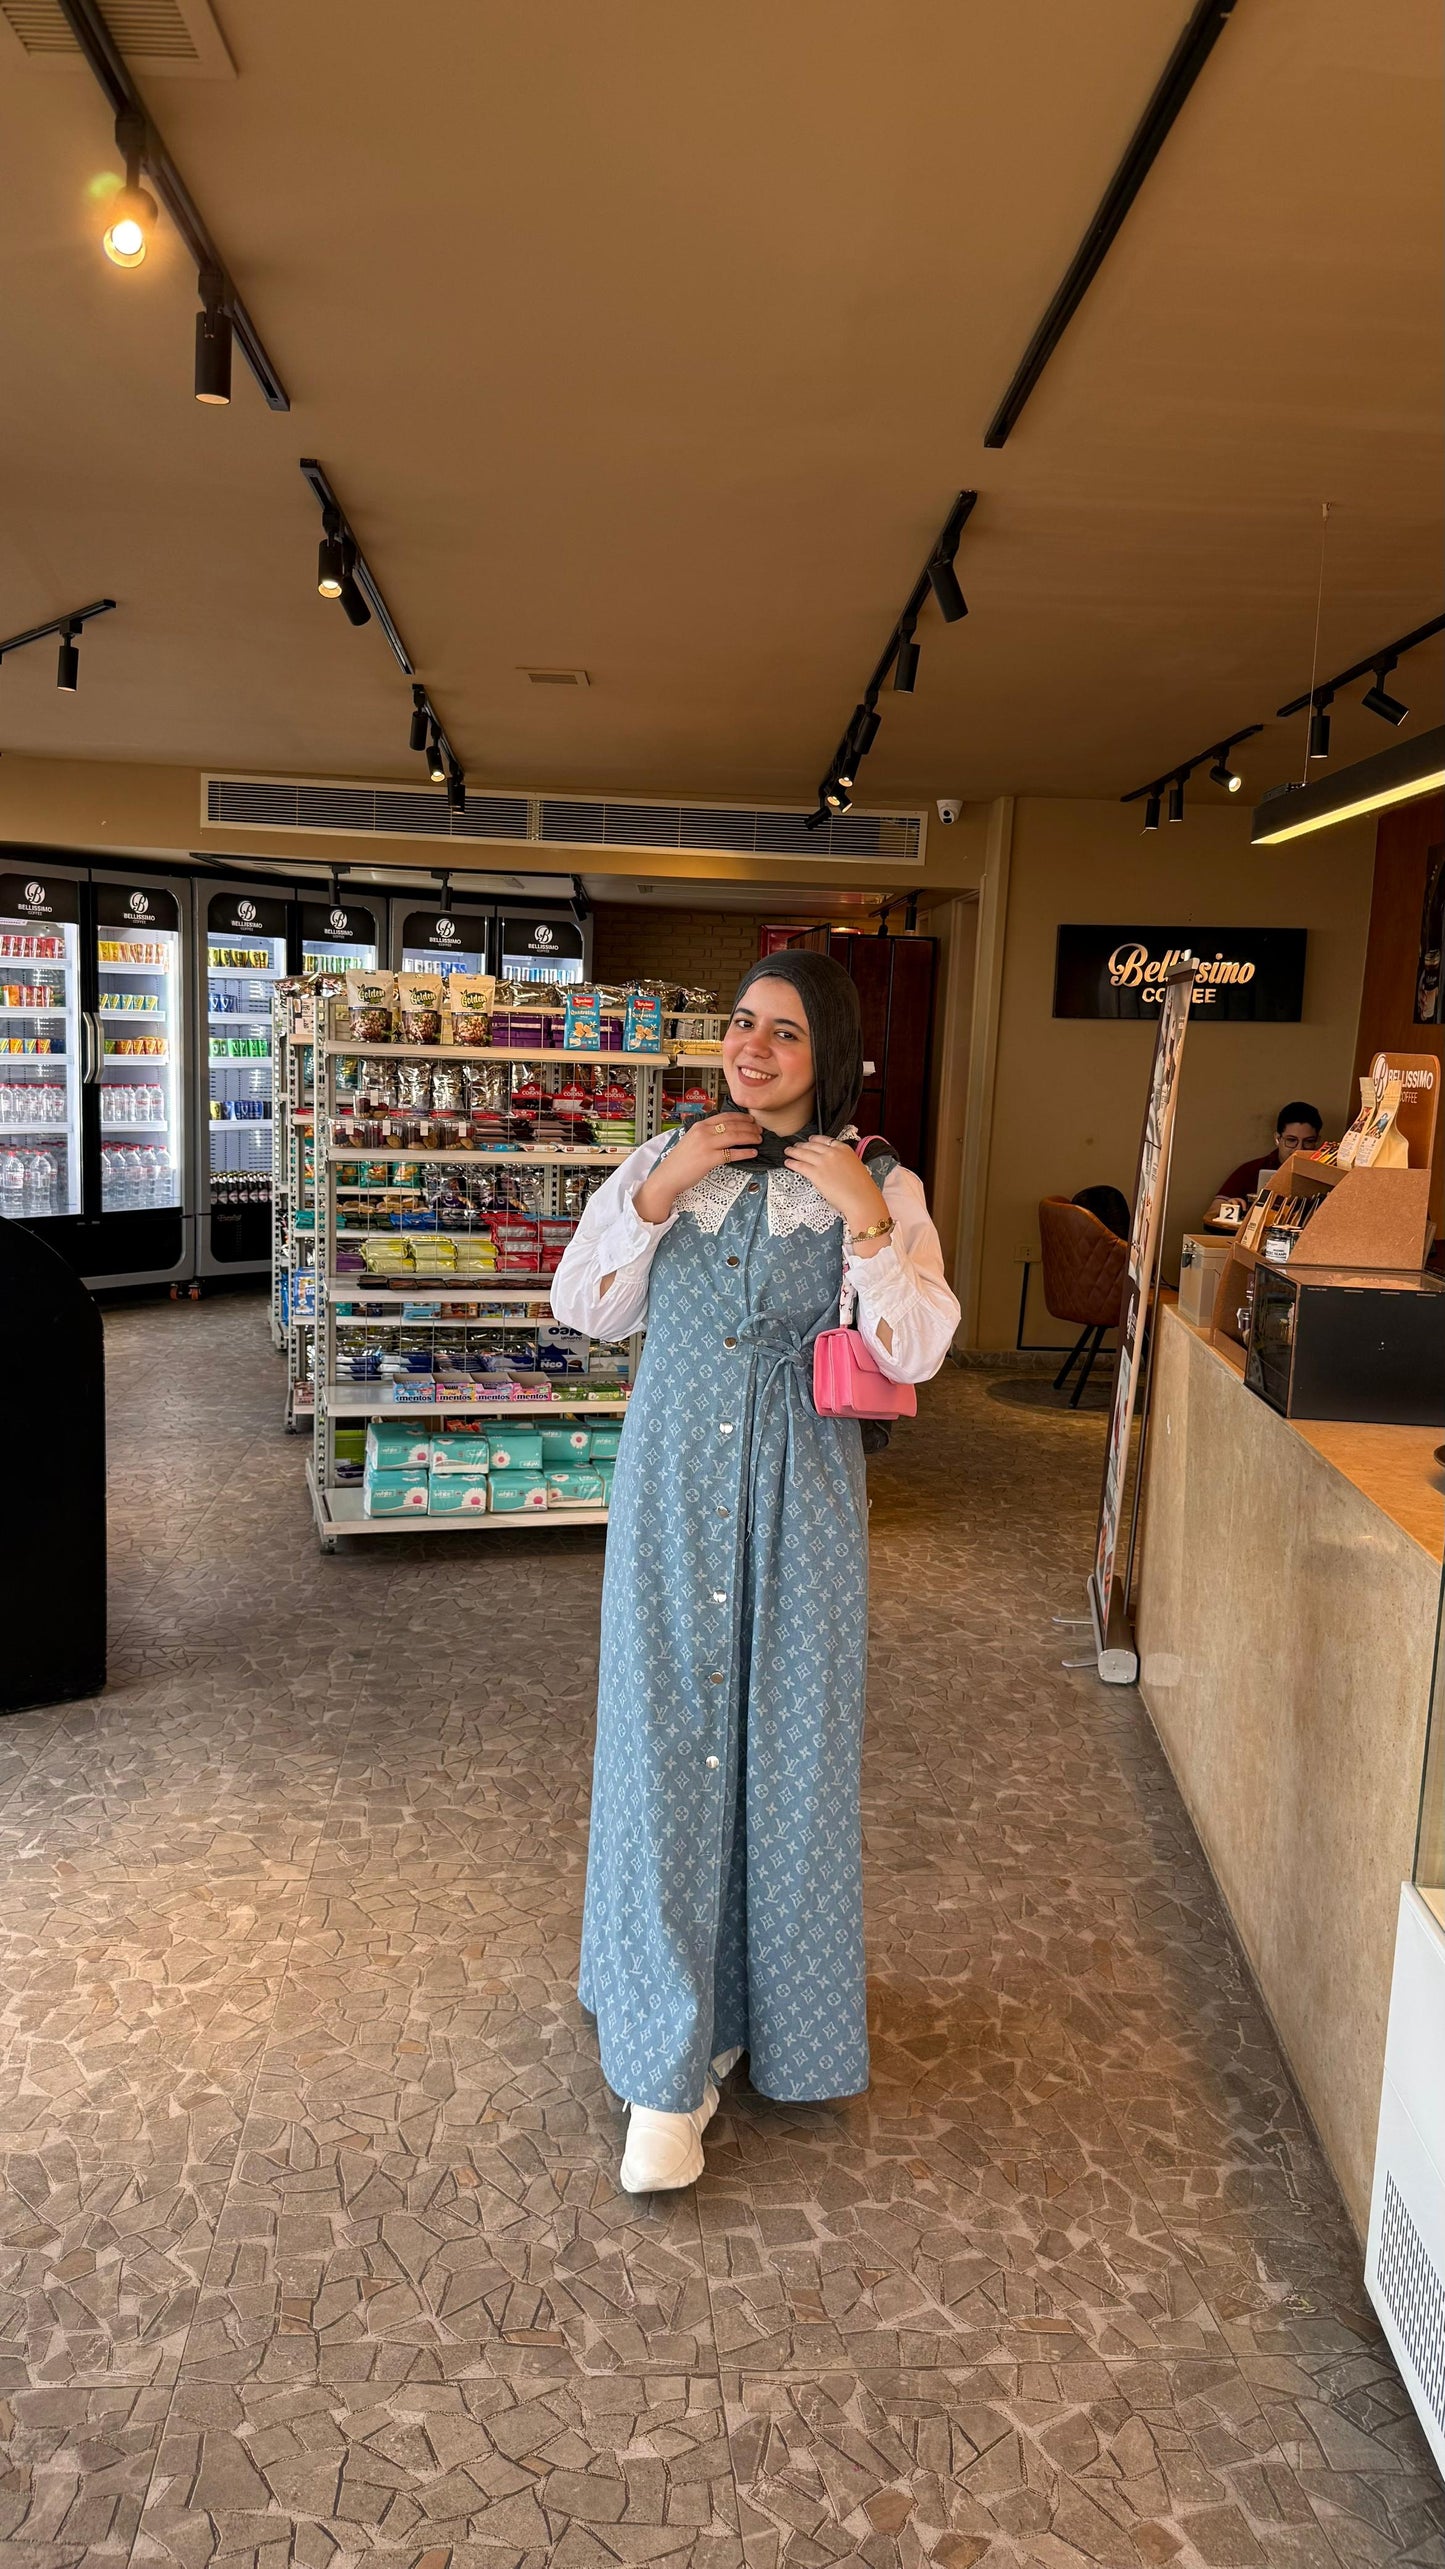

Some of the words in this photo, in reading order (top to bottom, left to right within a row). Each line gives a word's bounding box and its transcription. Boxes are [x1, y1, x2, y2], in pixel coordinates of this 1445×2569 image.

[18, 904, 53, 913] BELLISSIMO
[123, 913, 156, 921] BELLISSIMO
[231, 920, 263, 929] BELLISSIMO
[324, 928, 354, 937] BELLISSIMO
[429, 937, 461, 945] BELLISSIMO
[528, 943, 559, 951] BELLISSIMO
[358, 987, 385, 1001] Golden
[411, 990, 437, 1005] Golden
[1142, 987, 1216, 1003] COEE
[461, 992, 487, 1008] Golden
[1225, 1206, 1235, 1220] 2
